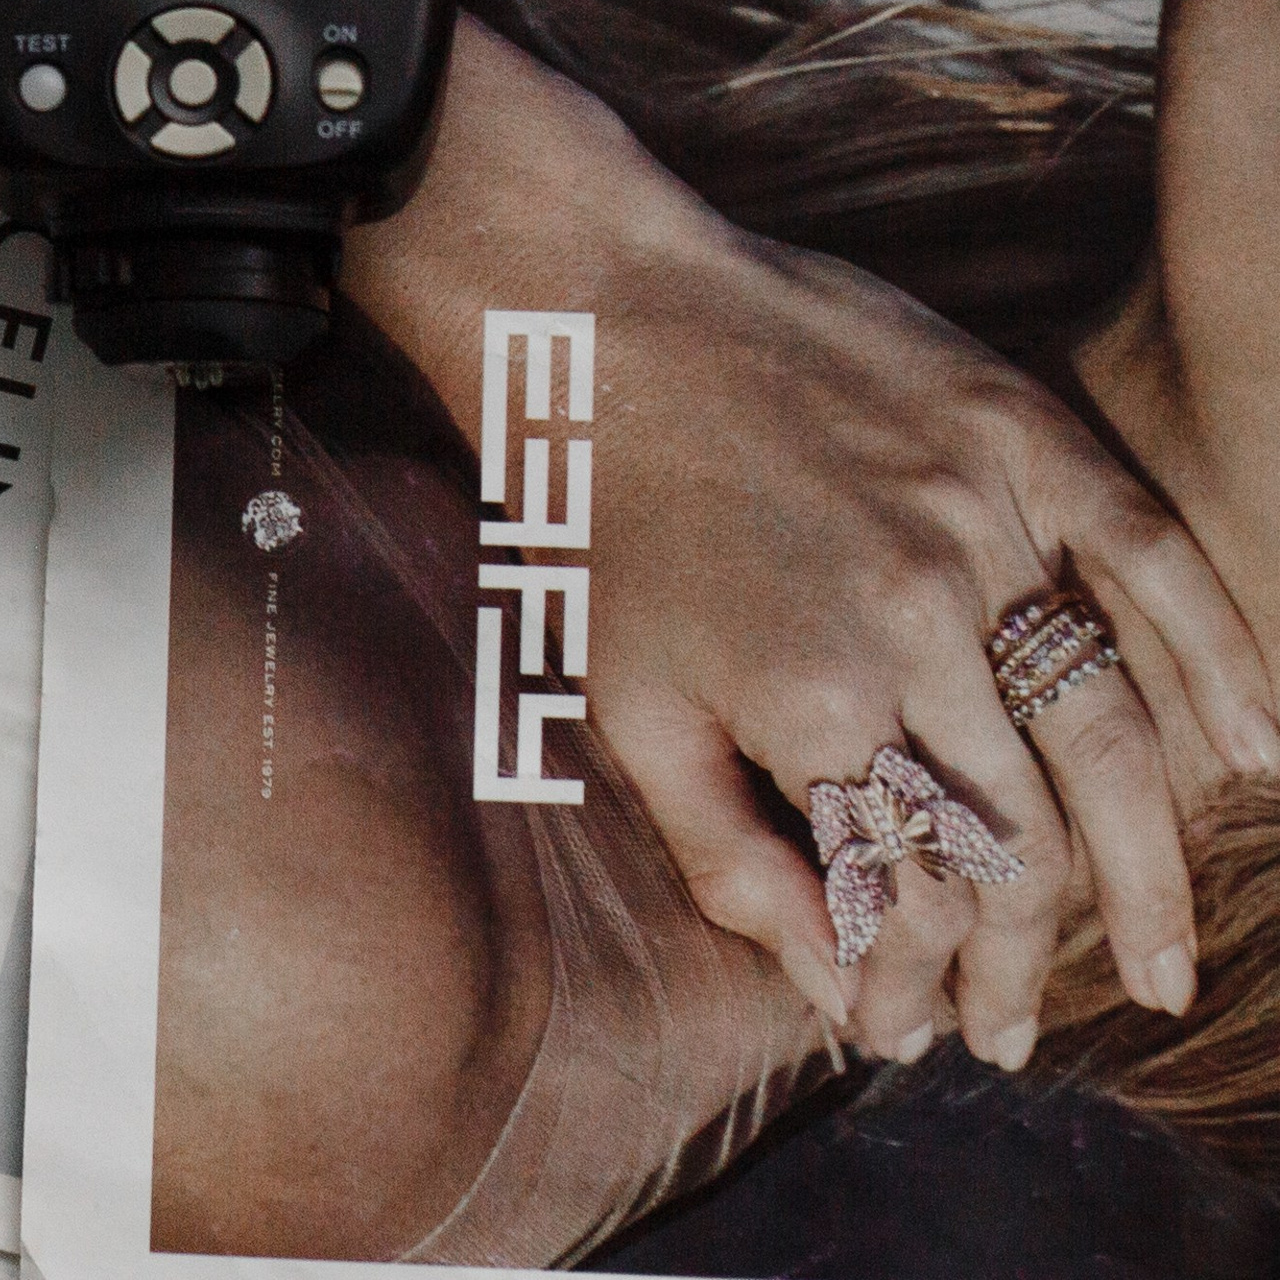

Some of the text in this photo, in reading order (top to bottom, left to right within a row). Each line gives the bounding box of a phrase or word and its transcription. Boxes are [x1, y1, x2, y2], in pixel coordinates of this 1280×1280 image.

[15, 33, 71, 53] TEST
[322, 24, 359, 42] ON
[316, 119, 363, 139] OFF
[266, 572, 279, 614] FINE
[264, 621, 277, 709] JEWELRY
